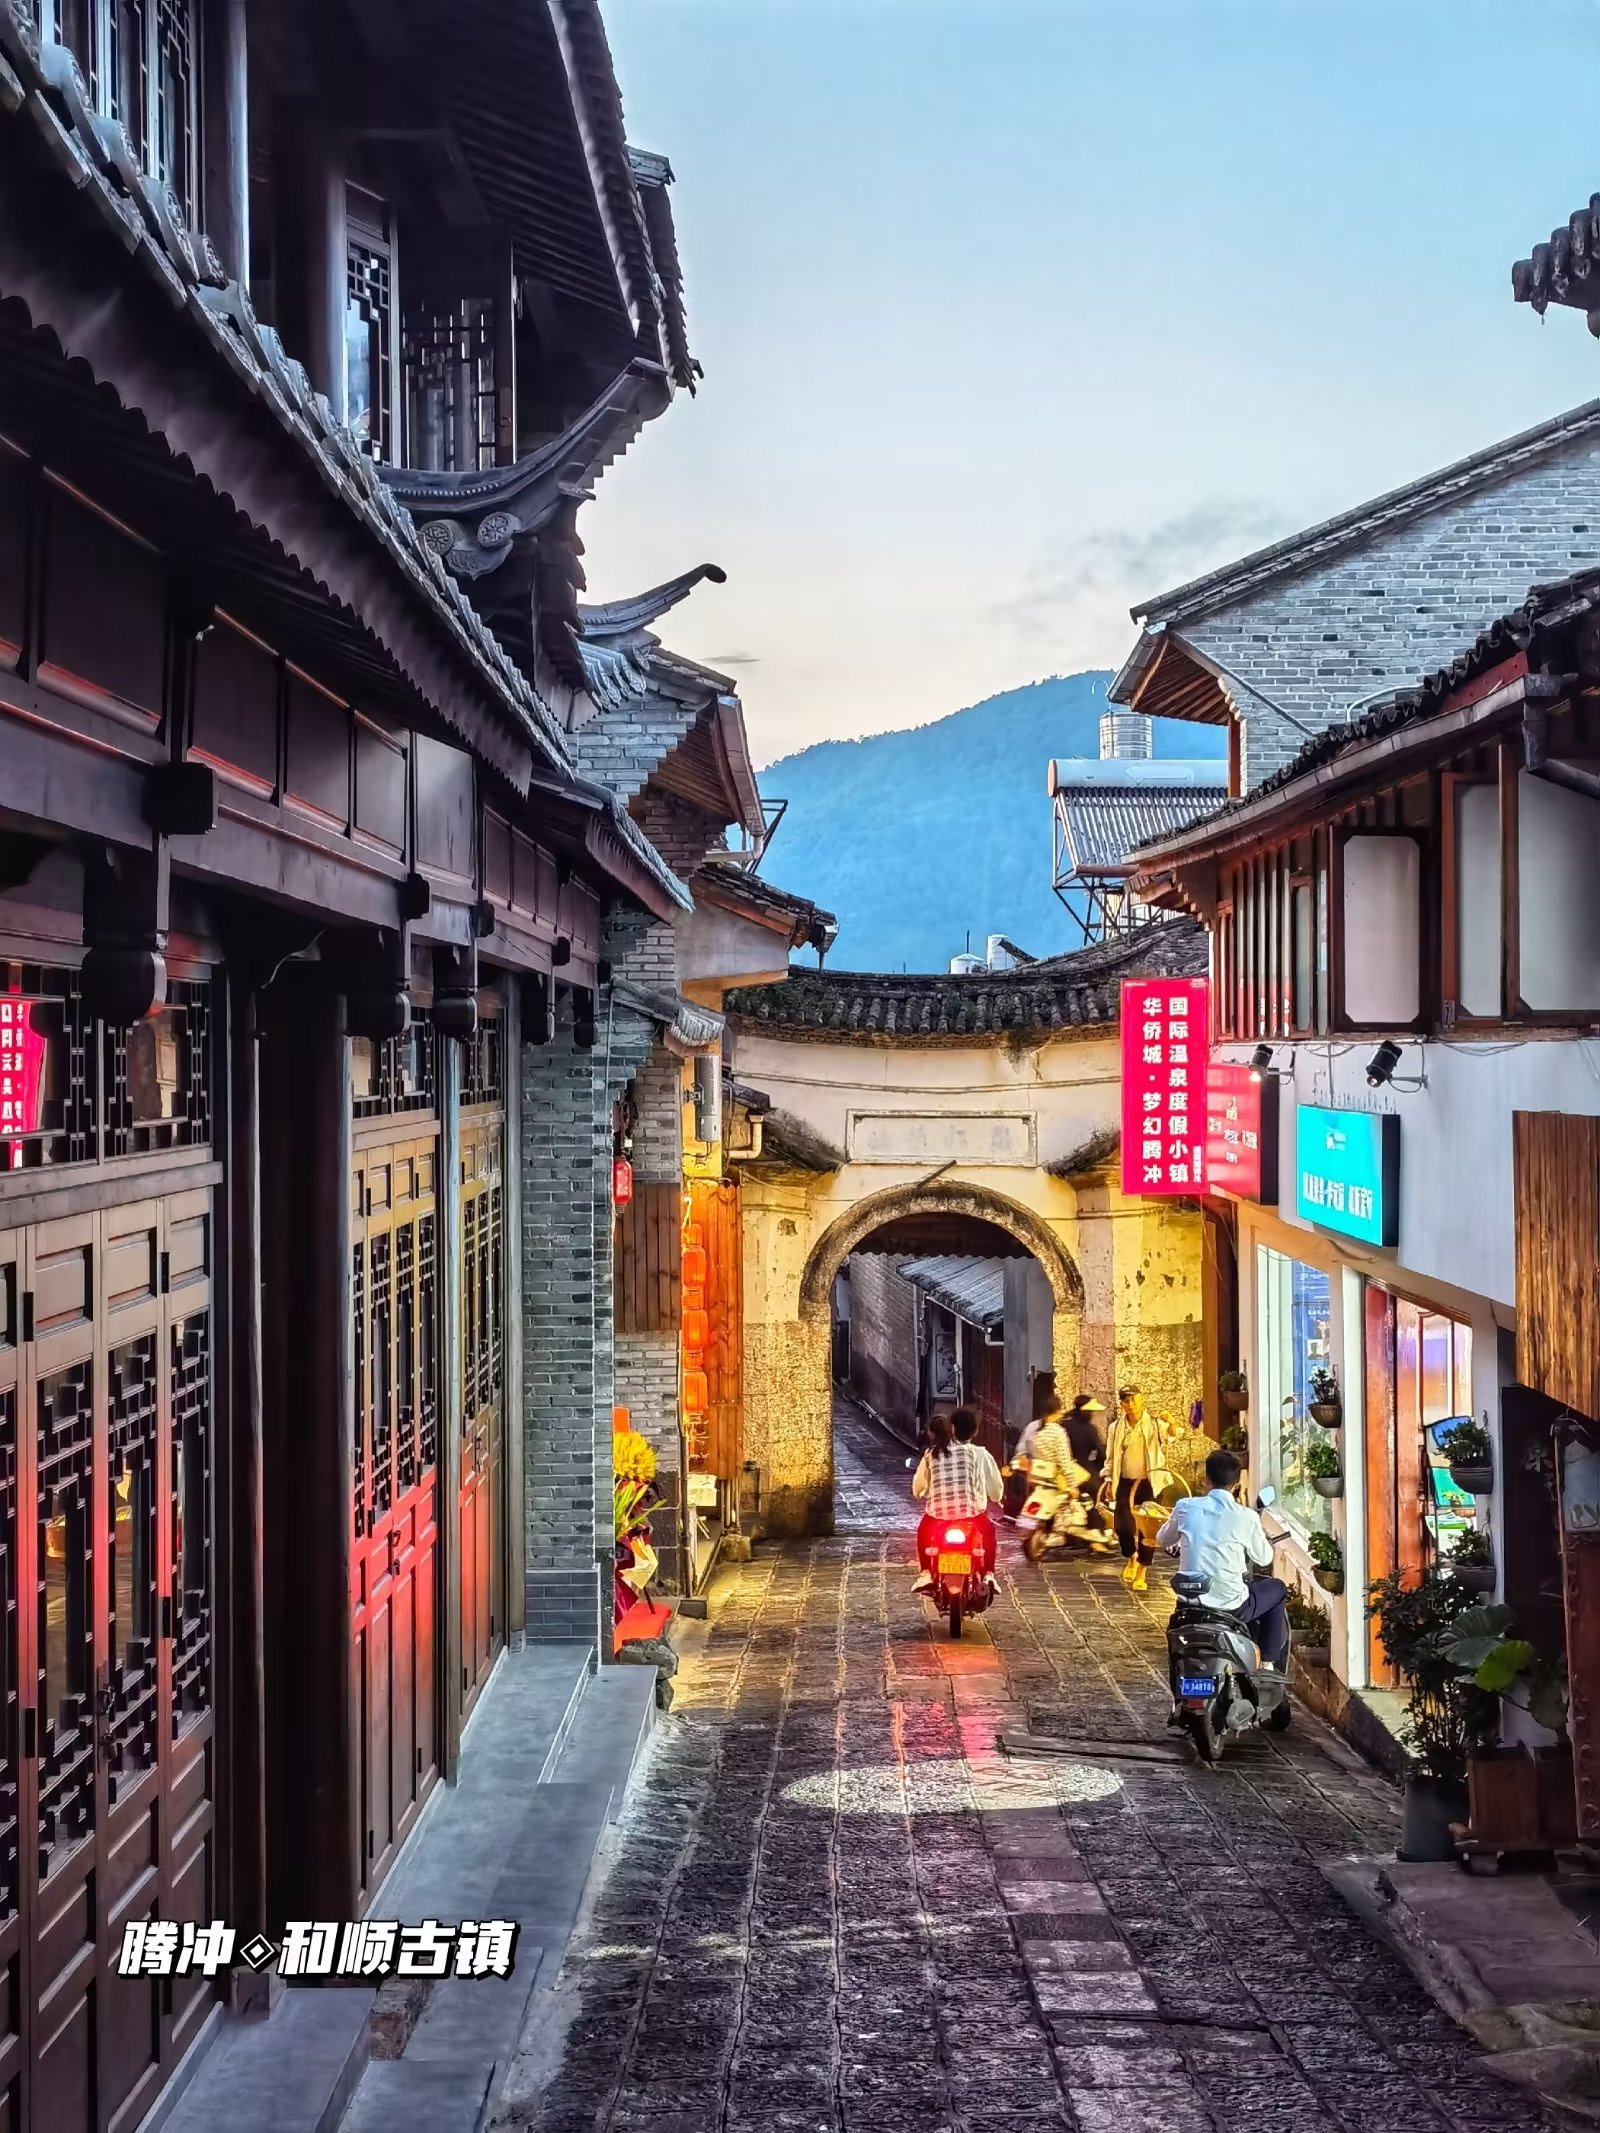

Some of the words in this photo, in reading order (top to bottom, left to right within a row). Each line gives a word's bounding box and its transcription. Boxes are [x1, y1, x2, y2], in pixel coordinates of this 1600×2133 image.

[1142, 997, 1162, 1183] 华侨城·梦幻腾冲
[1168, 997, 1188, 1183] 国际温泉度假小镇
